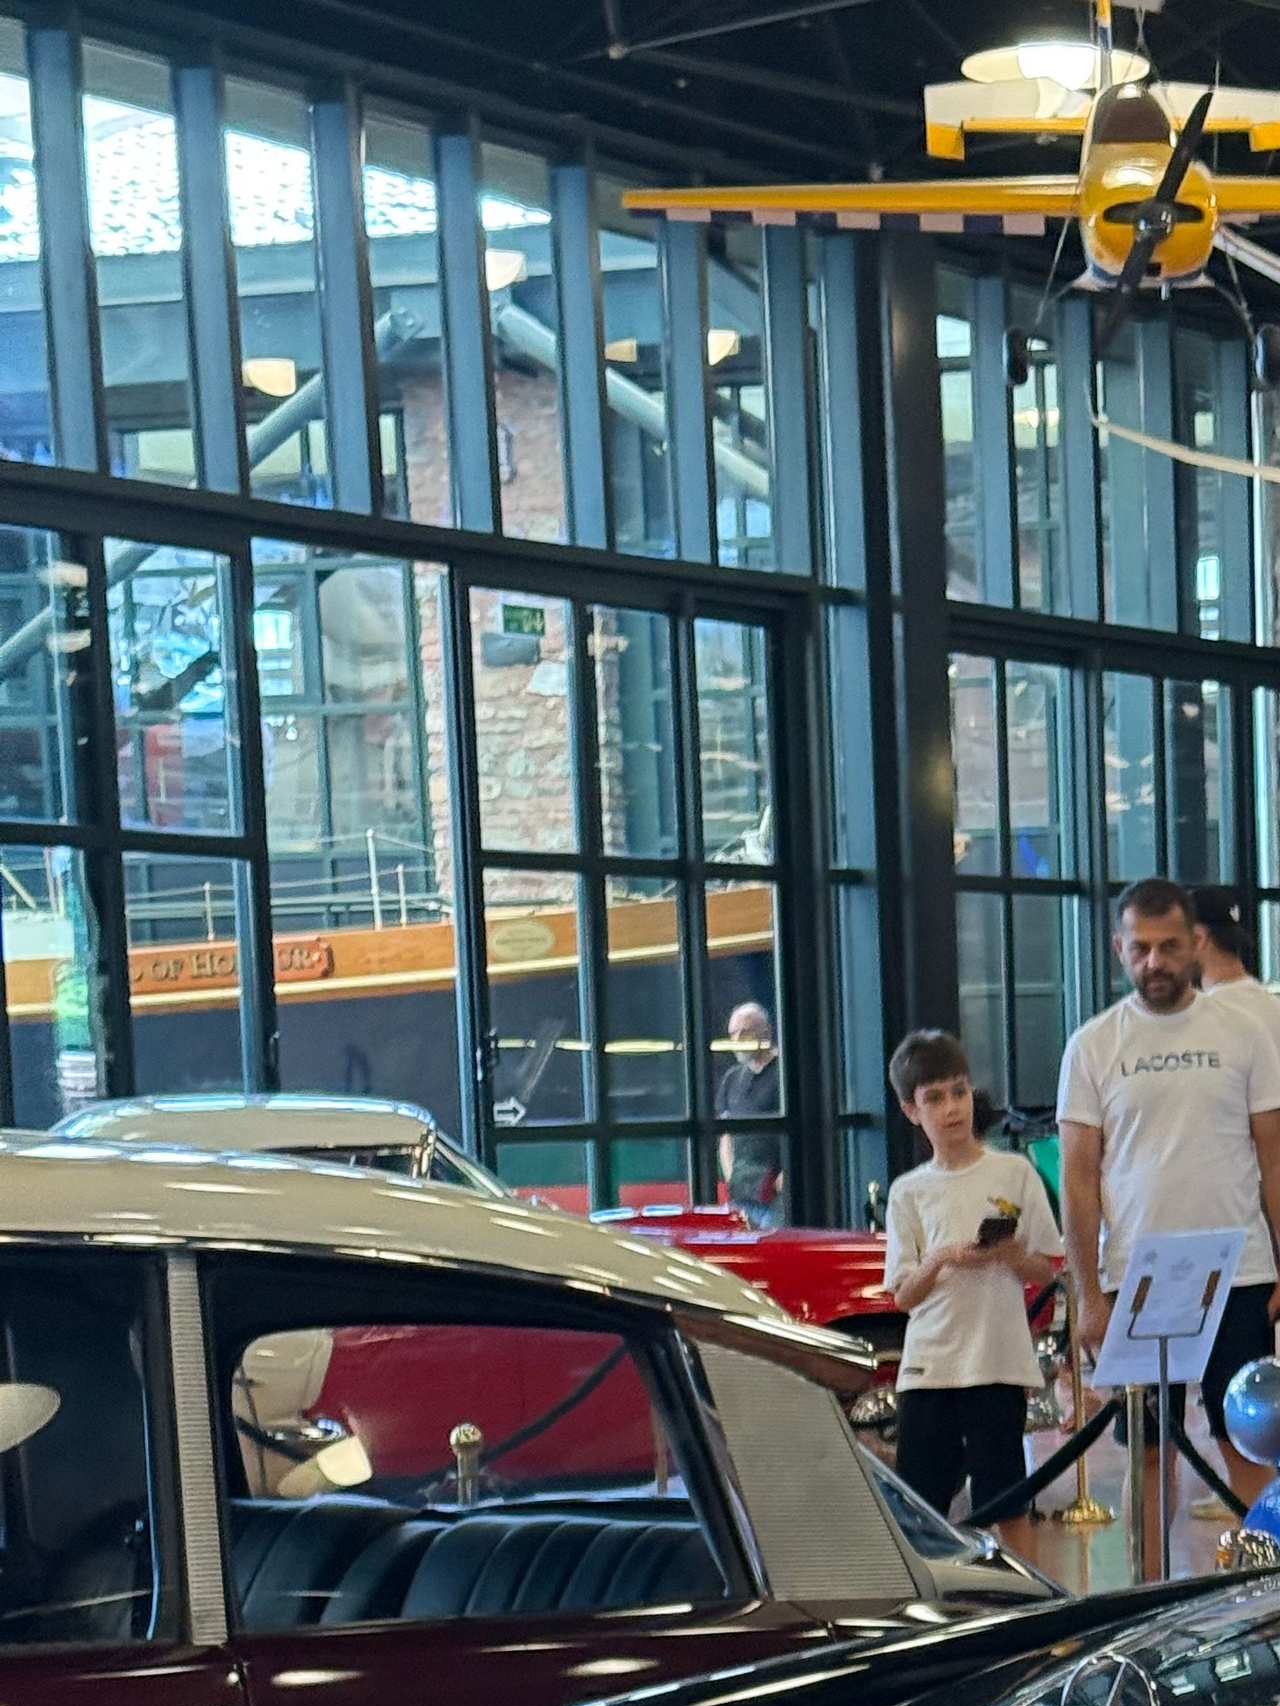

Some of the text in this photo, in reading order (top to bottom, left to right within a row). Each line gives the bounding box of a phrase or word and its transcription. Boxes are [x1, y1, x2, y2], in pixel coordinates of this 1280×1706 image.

[151, 958, 182, 980] OF
[192, 949, 316, 979] HOUR
[1120, 1049, 1221, 1077] LACOSTE
